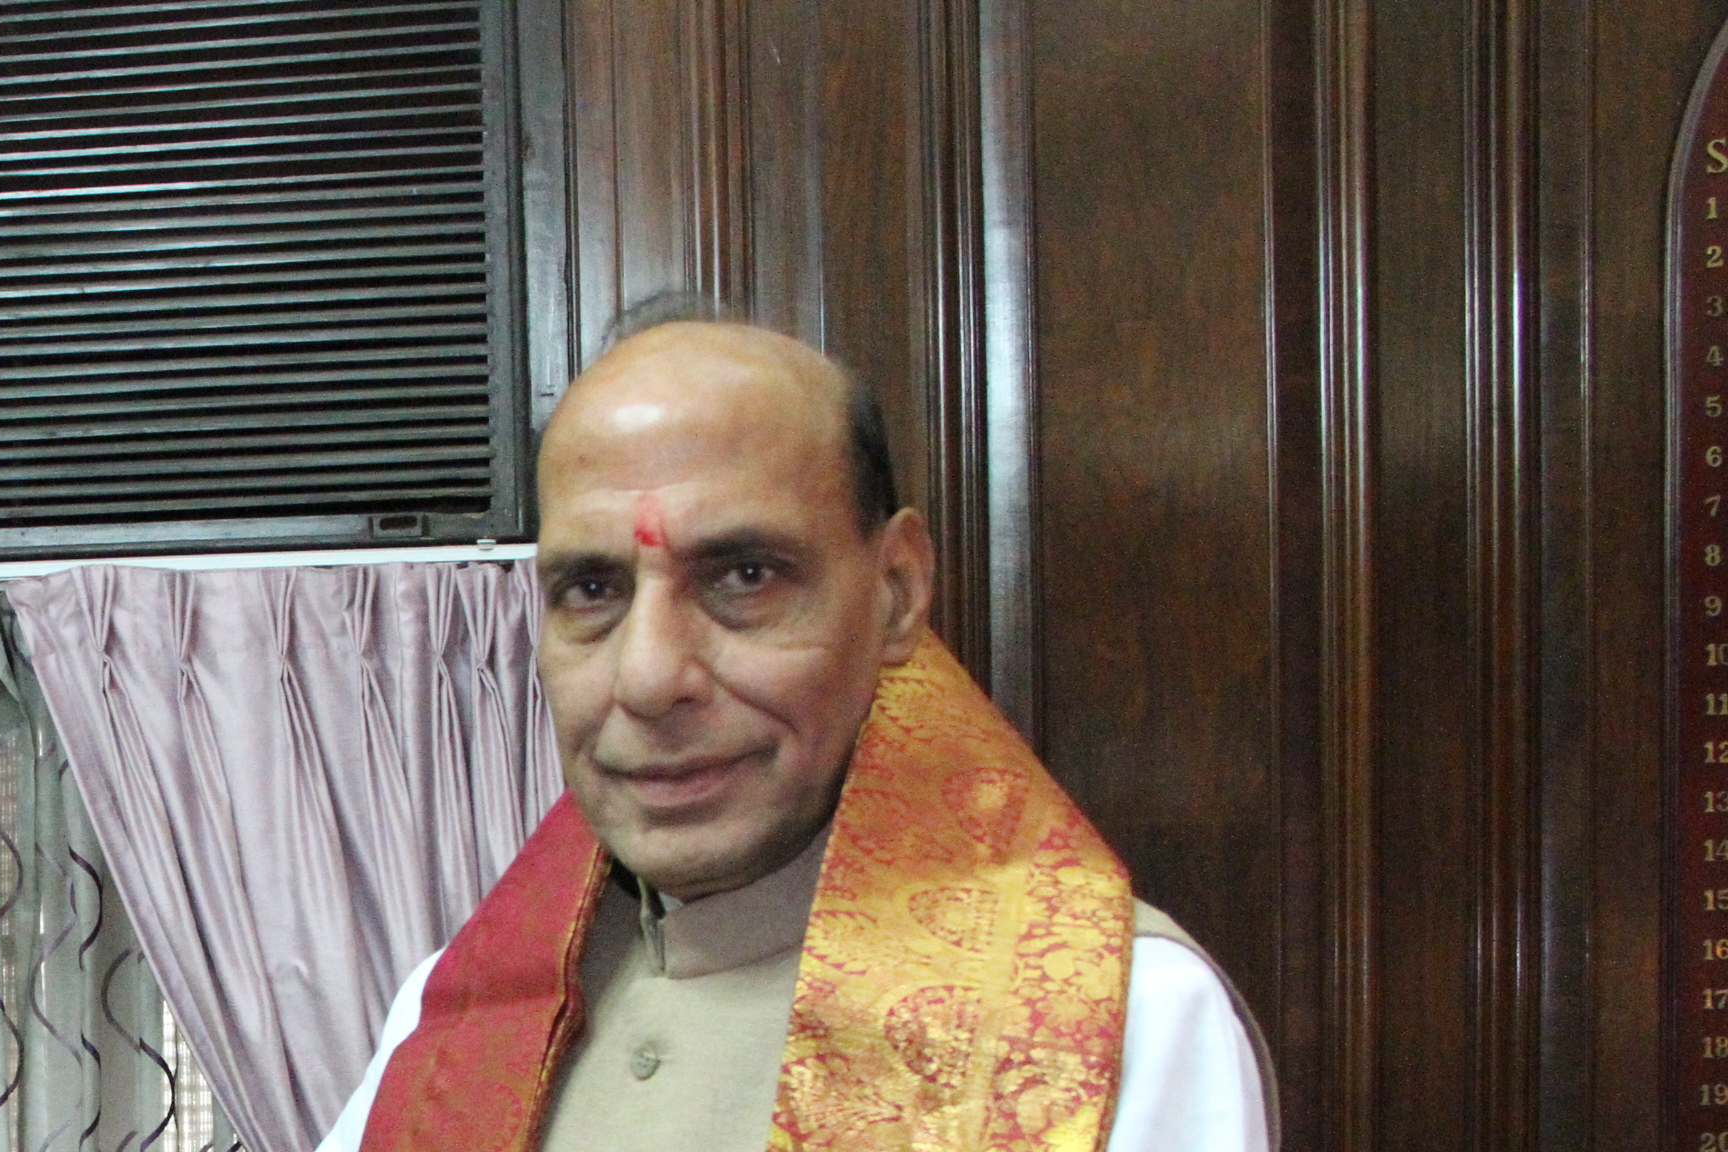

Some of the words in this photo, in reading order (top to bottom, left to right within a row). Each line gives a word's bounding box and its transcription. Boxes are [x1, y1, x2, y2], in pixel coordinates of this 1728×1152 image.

[1706, 197, 1718, 220] 1
[1706, 246, 1723, 268] 2
[1707, 295, 1723, 317] 3
[1706, 345, 1724, 367] 4
[1705, 396, 1722, 417] 5
[1705, 446, 1723, 467] 6
[1704, 495, 1721, 517] 7
[1704, 545, 1722, 567] 8
[1704, 596, 1722, 617] 9
[1705, 693, 1728, 715] 11
[1703, 939, 1728, 960] 16
[1702, 988, 1728, 1010] 17
[1702, 1036, 1728, 1058] 18
[1700, 1083, 1728, 1106] 19
